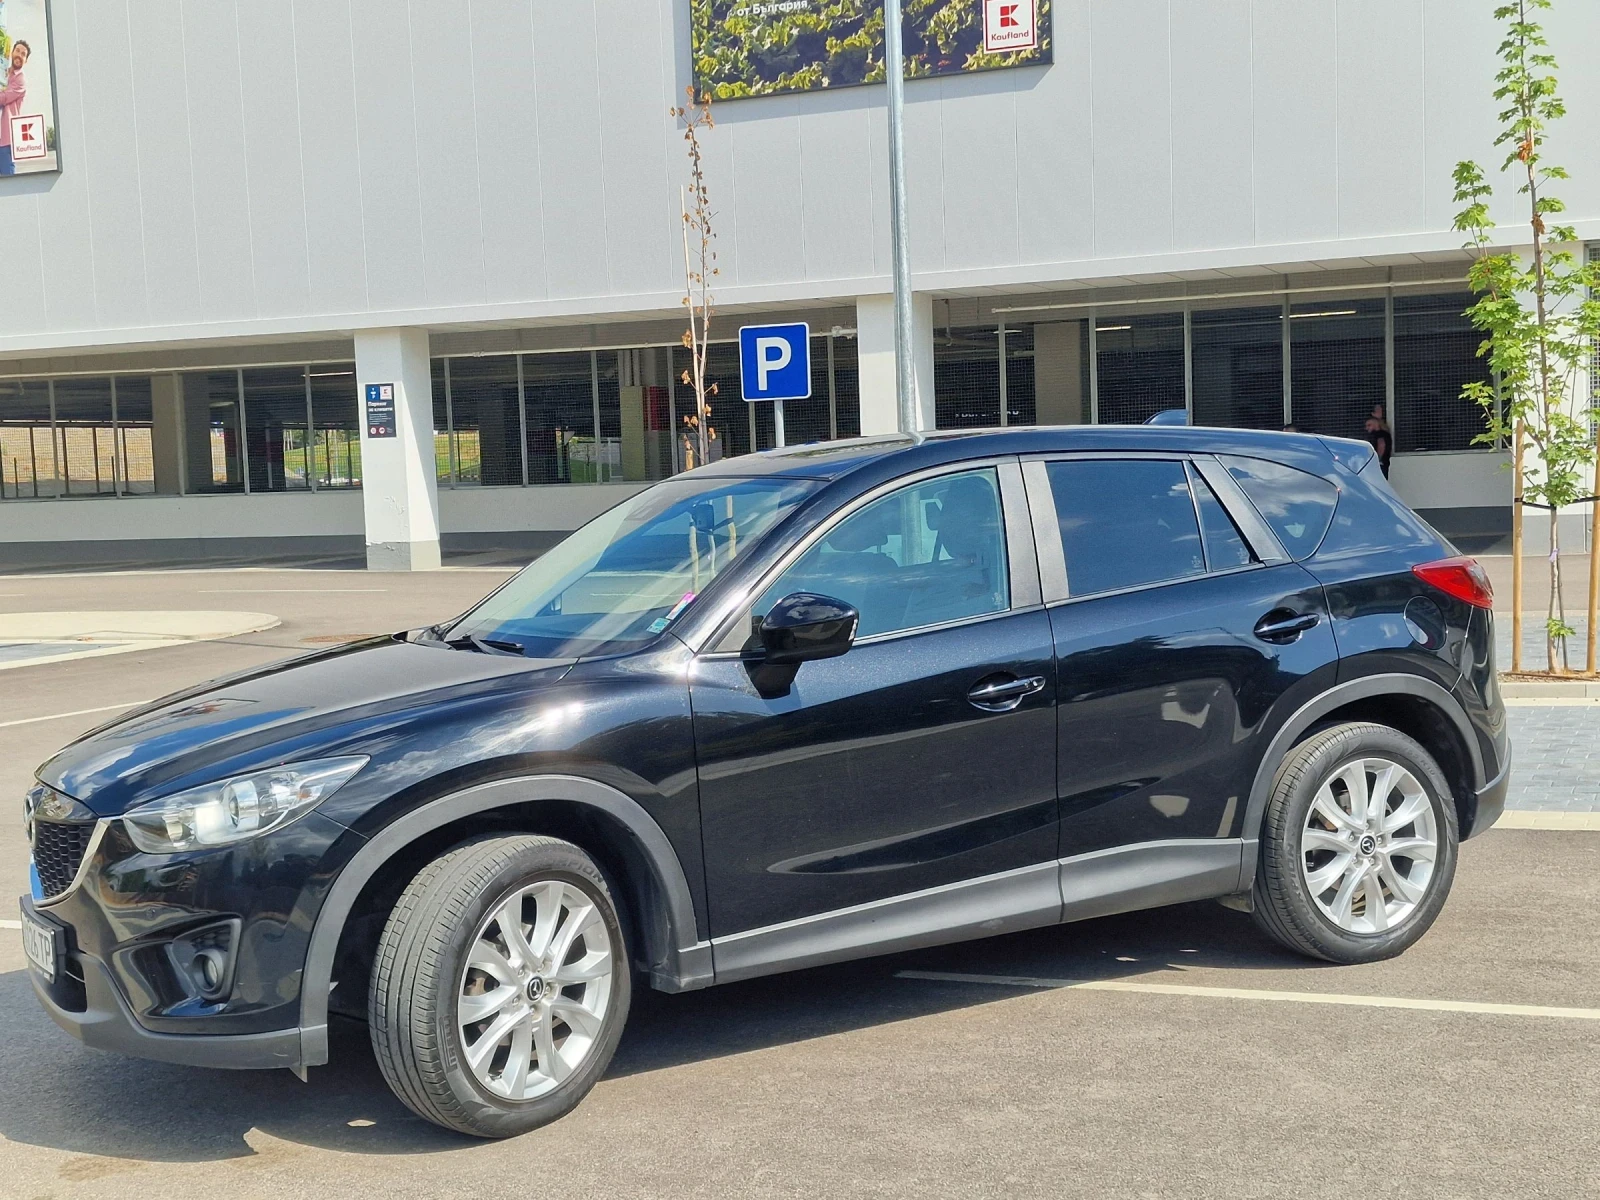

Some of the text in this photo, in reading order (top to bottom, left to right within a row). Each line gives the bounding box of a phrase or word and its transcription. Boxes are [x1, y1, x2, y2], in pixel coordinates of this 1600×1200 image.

[737, 7, 750, 17] от
[991, 30, 1029, 41] Kaufland
[16, 144, 42, 152] Kaufland
[757, 337, 792, 391] P
